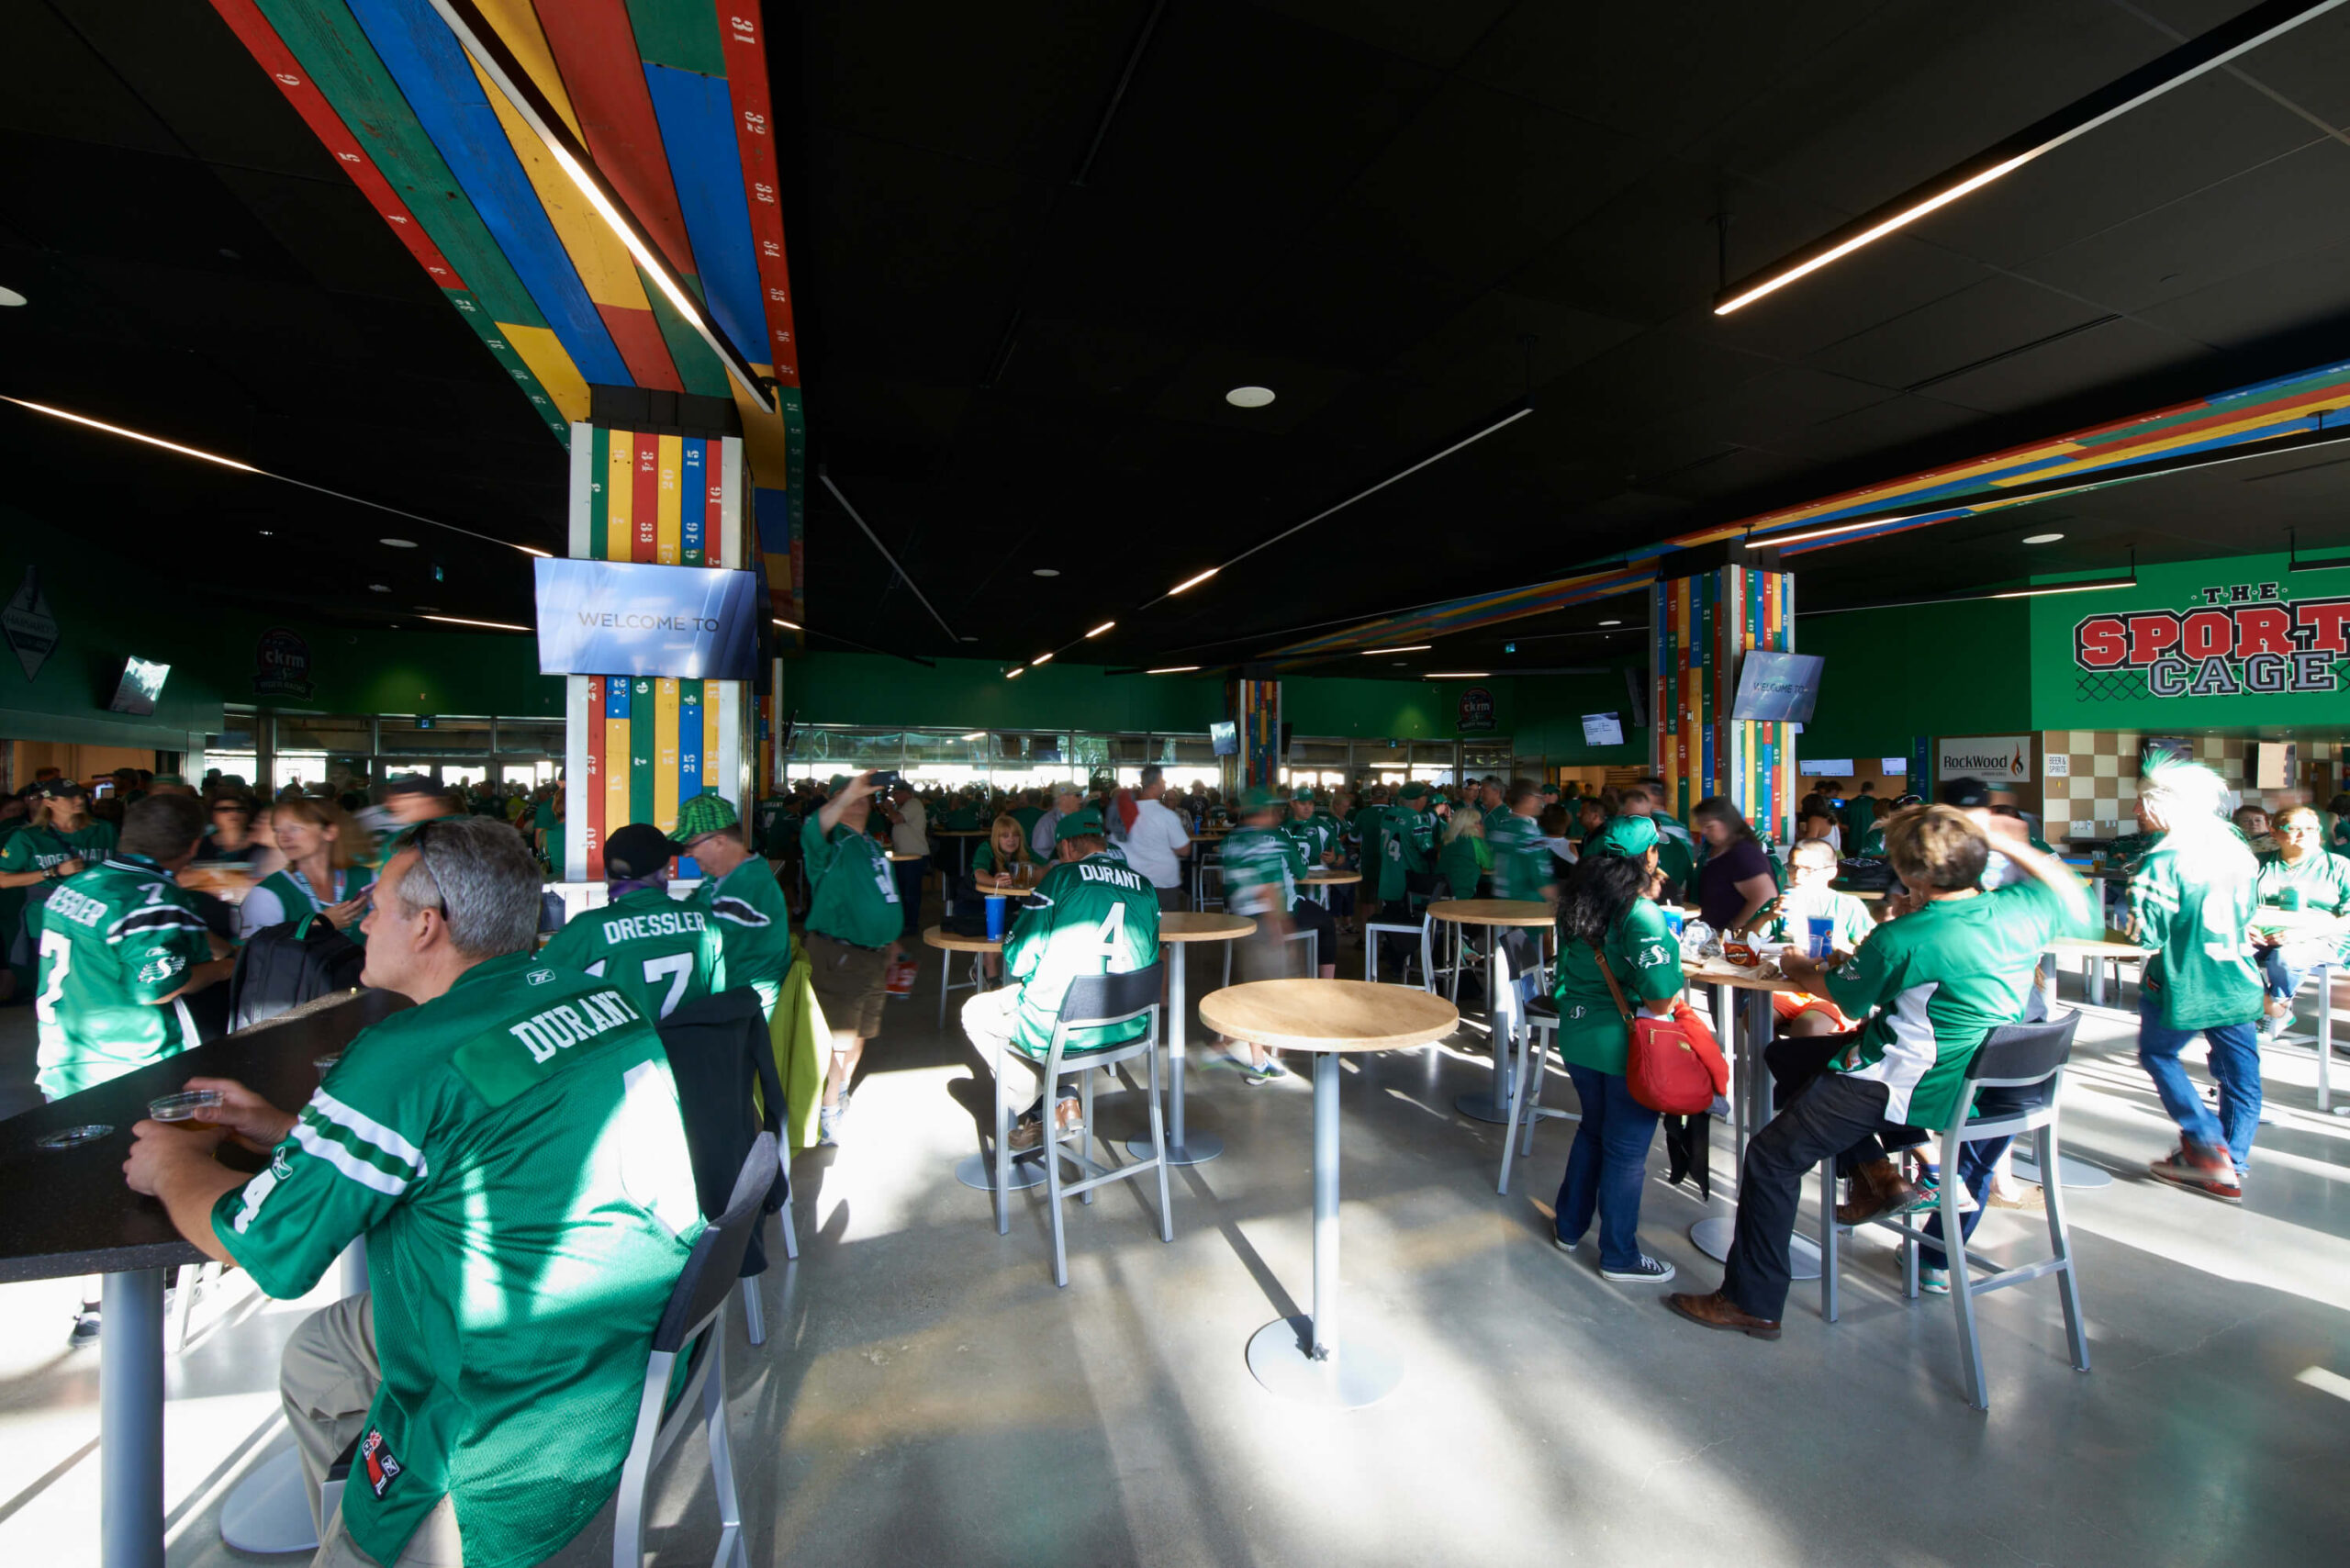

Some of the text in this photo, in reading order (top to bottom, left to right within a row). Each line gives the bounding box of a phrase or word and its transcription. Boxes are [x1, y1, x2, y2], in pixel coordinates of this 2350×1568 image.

[732, 17, 755, 44] 31
[744, 111, 767, 135] 32
[755, 183, 774, 203] 33
[764, 241, 780, 257] 34
[771, 287, 785, 302] 35
[642, 451, 654, 472] 34
[687, 450, 699, 467] 15
[662, 469, 674, 490] 20
[710, 487, 721, 504] 16
[641, 522, 653, 543] 33
[686, 522, 698, 540] 16
[578, 611, 719, 633] WELCOME TO
[2148, 650, 2338, 698] CAGE
[1753, 682, 1805, 694] WELCOME TO
[684, 755, 696, 773] 25
[1943, 755, 2008, 768] RockWood
[2049, 756, 2066, 765] BEER &
[1079, 864, 1142, 891] DURANT
[603, 912, 707, 945] DRESSLER
[1096, 902, 1126, 974] 4
[36, 929, 72, 1025] 7
[643, 952, 694, 1020] 7
[509, 991, 640, 1065] DURANT
